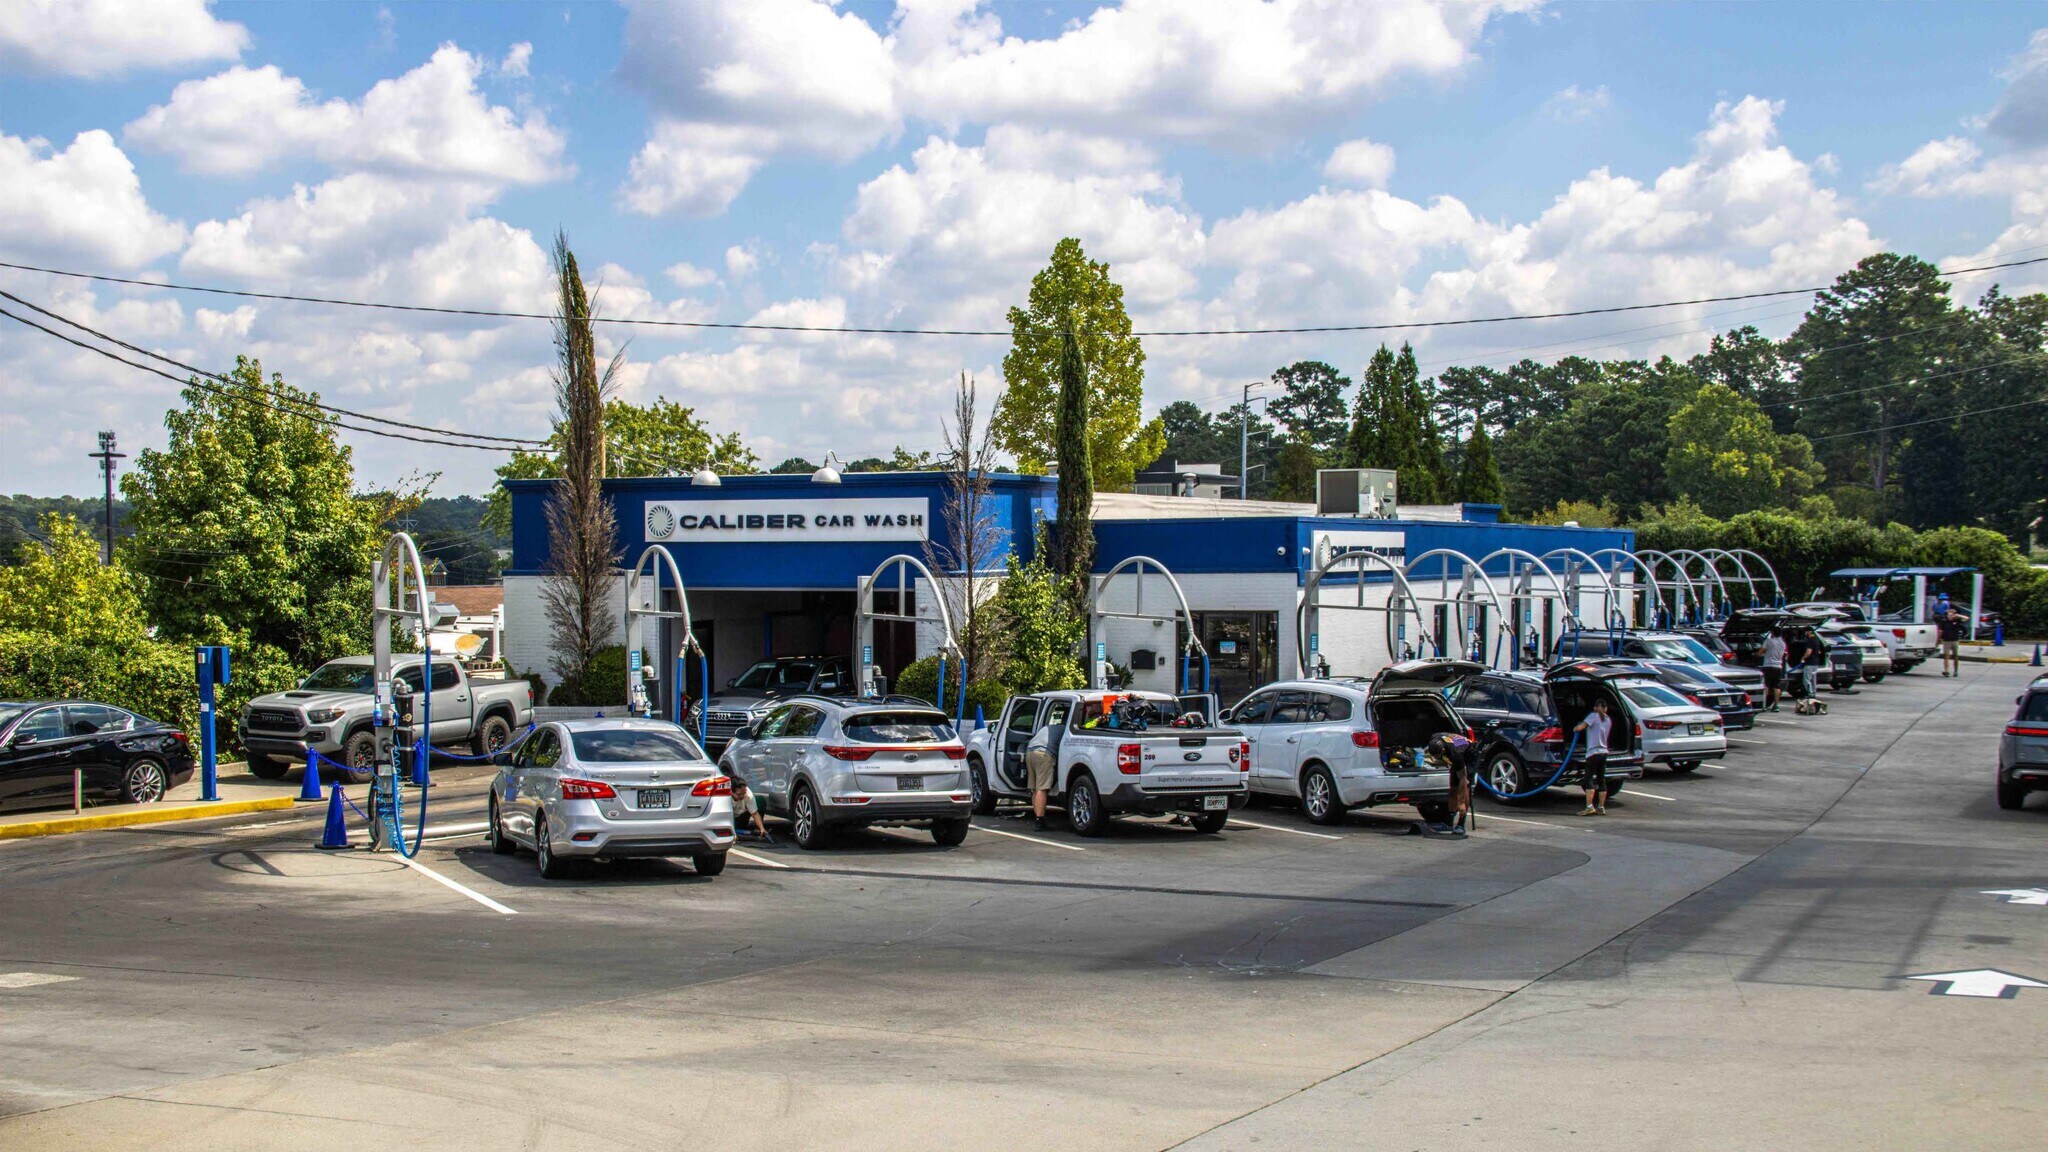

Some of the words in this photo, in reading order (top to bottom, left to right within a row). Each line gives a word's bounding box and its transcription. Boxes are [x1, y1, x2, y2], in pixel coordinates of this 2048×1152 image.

[679, 514, 806, 529] CALIBER
[814, 515, 854, 527] CAR
[864, 514, 923, 527] WASH
